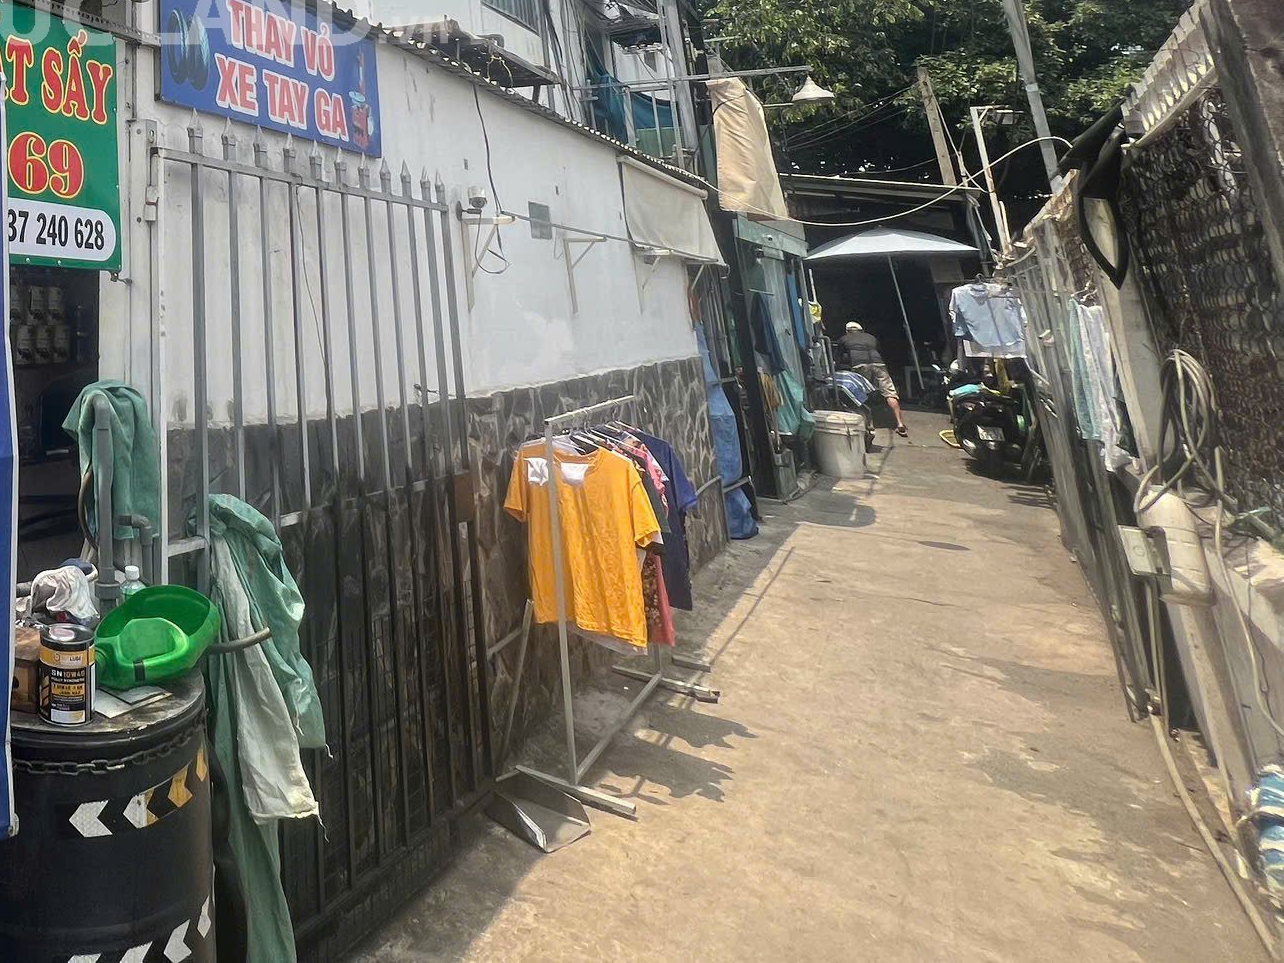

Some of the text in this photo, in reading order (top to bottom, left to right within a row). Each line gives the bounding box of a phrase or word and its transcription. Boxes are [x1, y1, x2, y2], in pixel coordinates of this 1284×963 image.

[41, 29, 113, 125] SẤY
[301, 22, 336, 81] VỎ
[214, 53, 349, 142] XE TAY GA
[7, 131, 85, 199] 69
[36, 212, 69, 247] 240
[74, 217, 105, 250] 628
